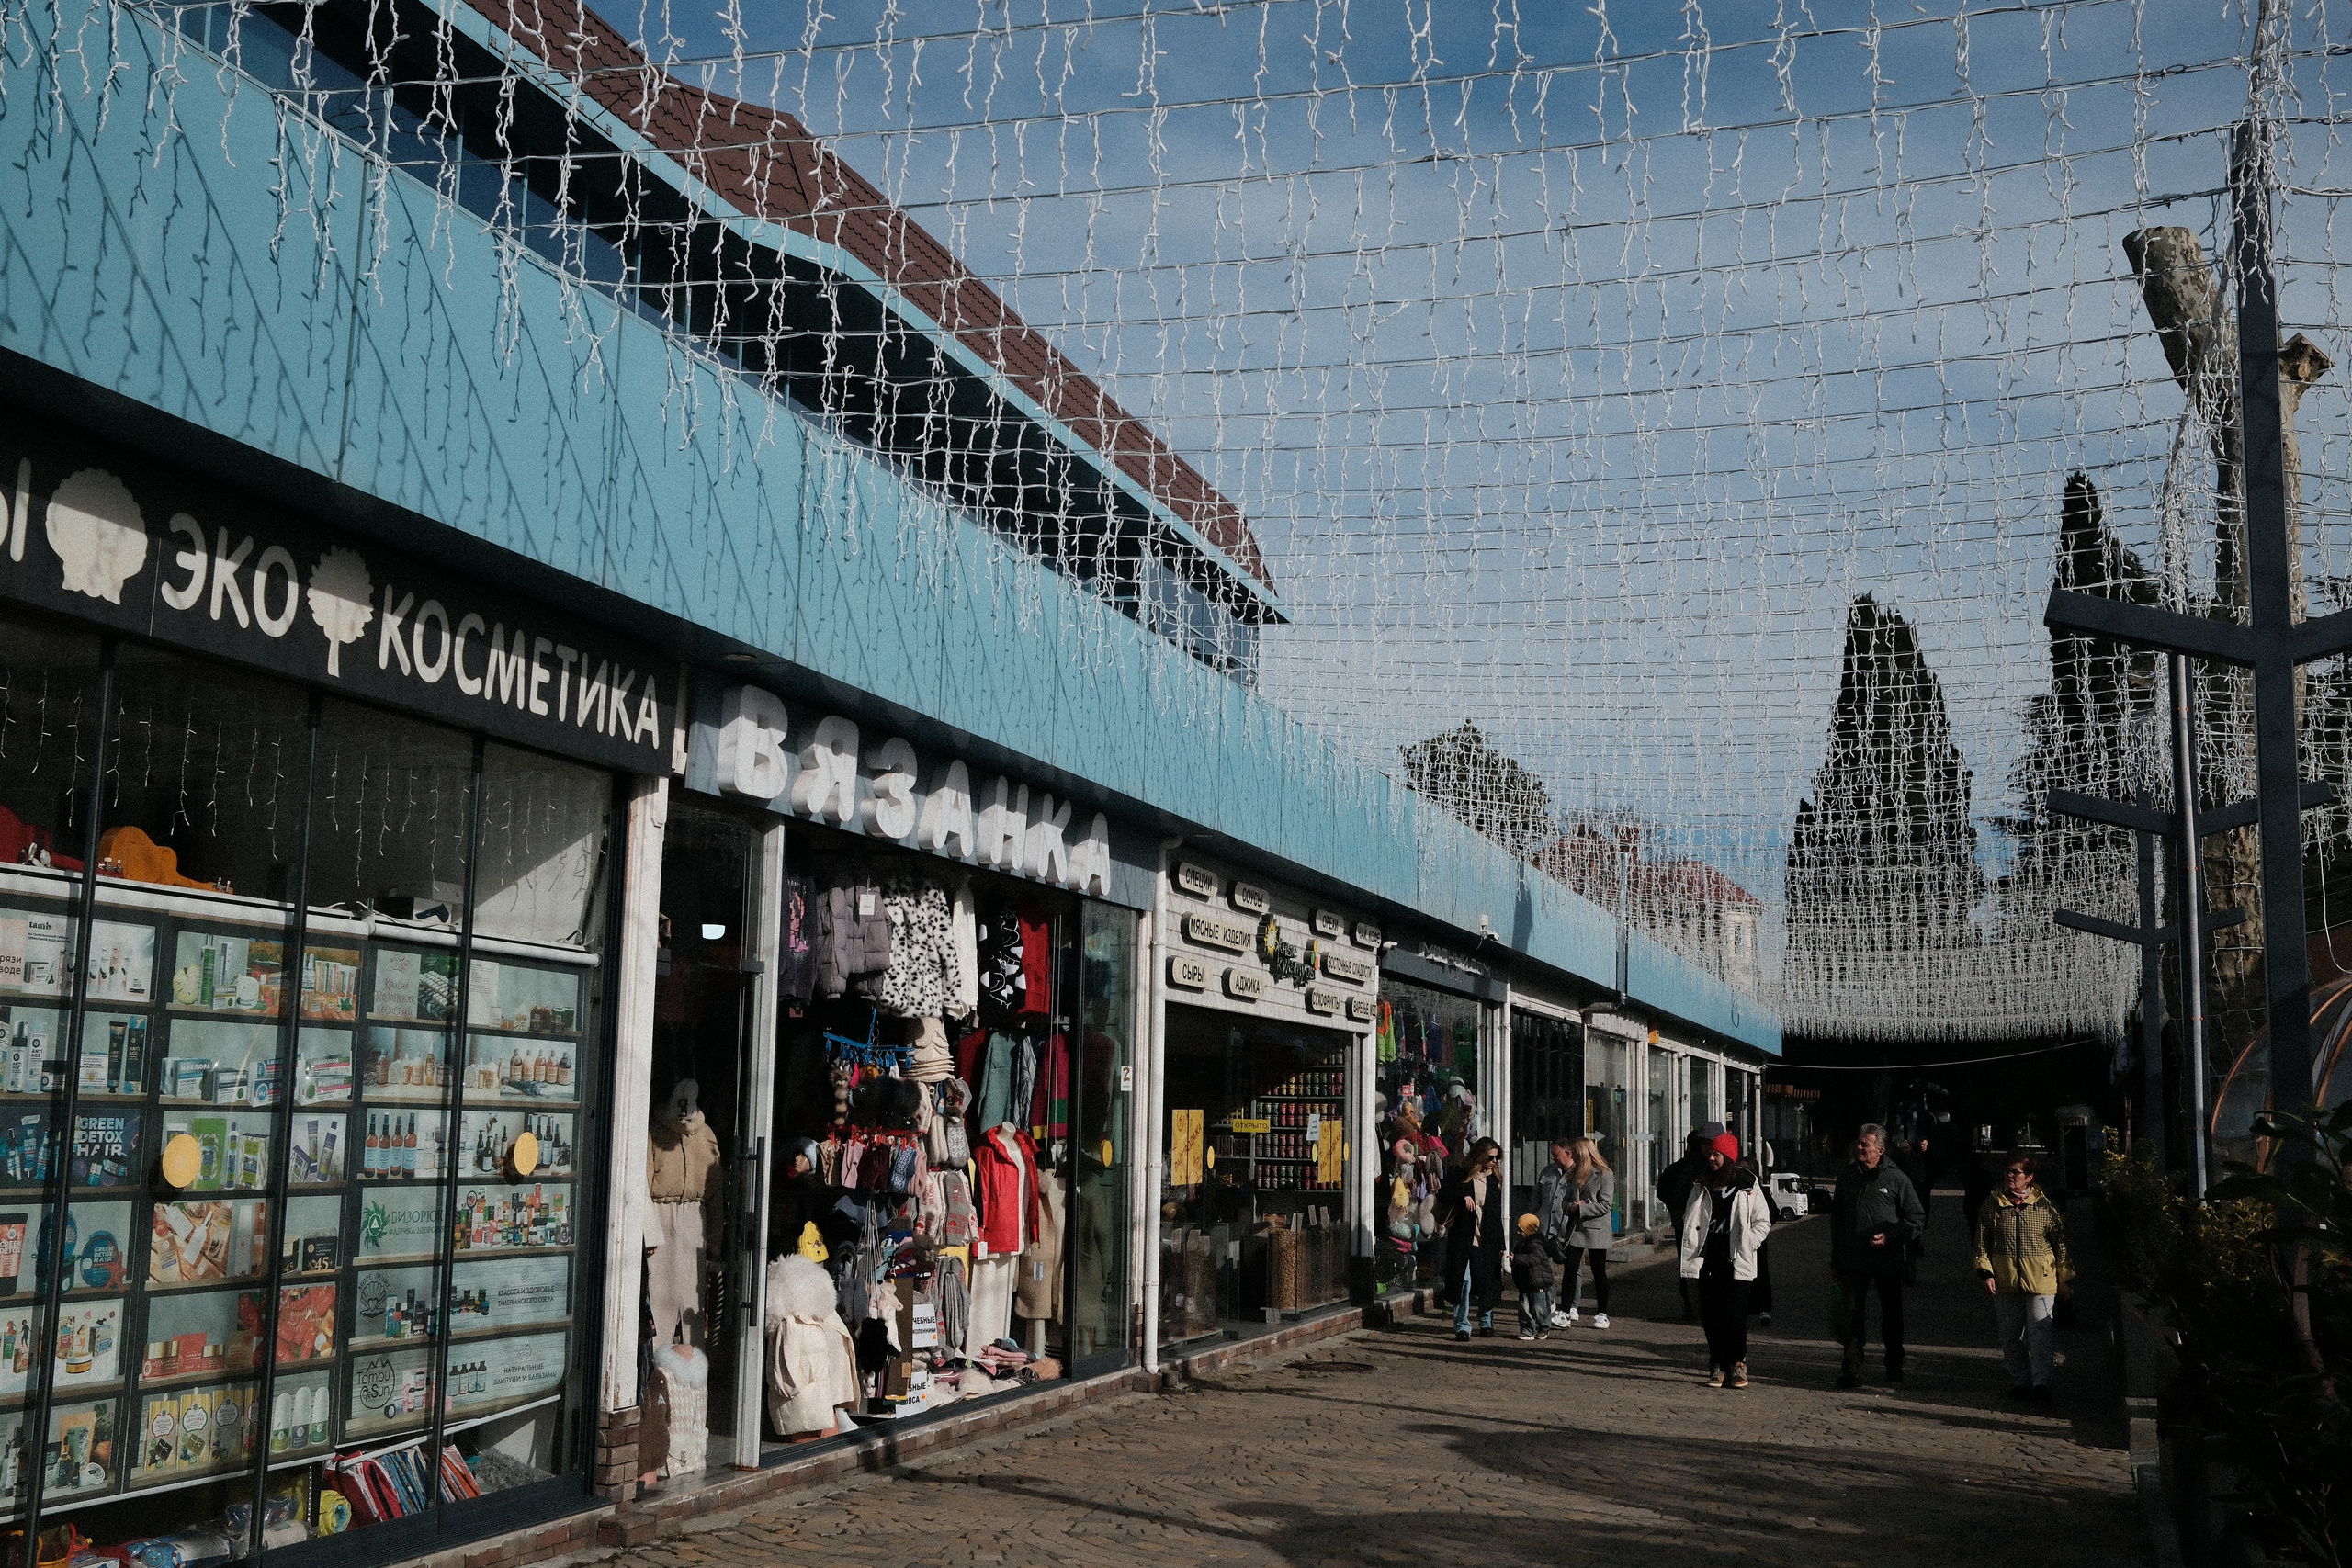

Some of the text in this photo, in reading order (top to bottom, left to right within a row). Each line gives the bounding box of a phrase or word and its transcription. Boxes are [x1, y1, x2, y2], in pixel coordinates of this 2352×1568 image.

[160, 511, 300, 639] ЭКО
[378, 582, 661, 750] КОСМЕТИКА
[717, 683, 1112, 897] ВЯЗАНКА
[1185, 868, 1213, 892] СПЕЦИИ
[1241, 887, 1263, 908] СОУСЫ
[1190, 918, 1251, 948] МЯСНЫЕ ИЗДЕЛИЯ
[1182, 963, 1204, 983] СЫРЫ
[1235, 976, 1261, 995] АДЖИКА
[1123, 1066, 1131, 1082] 2
[80, 1117, 125, 1131] GREEN
[79, 1131, 123, 1144] DETOX
[77, 1144, 124, 1156] HAIR
[391, 1209, 444, 1224] БИЗОРЮК
[498, 1289, 520, 1297] КРАСОТА
[526, 1286, 555, 1294] ЗДОРОВЬЕ
[503, 1363, 544, 1374] НАТУРАЛЬНЫЕ
[356, 1370, 390, 1385] Tambu
[493, 1376, 521, 1385] ШАМПУНИ
[527, 1371, 558, 1381] БАЛЬЗАМЫ
